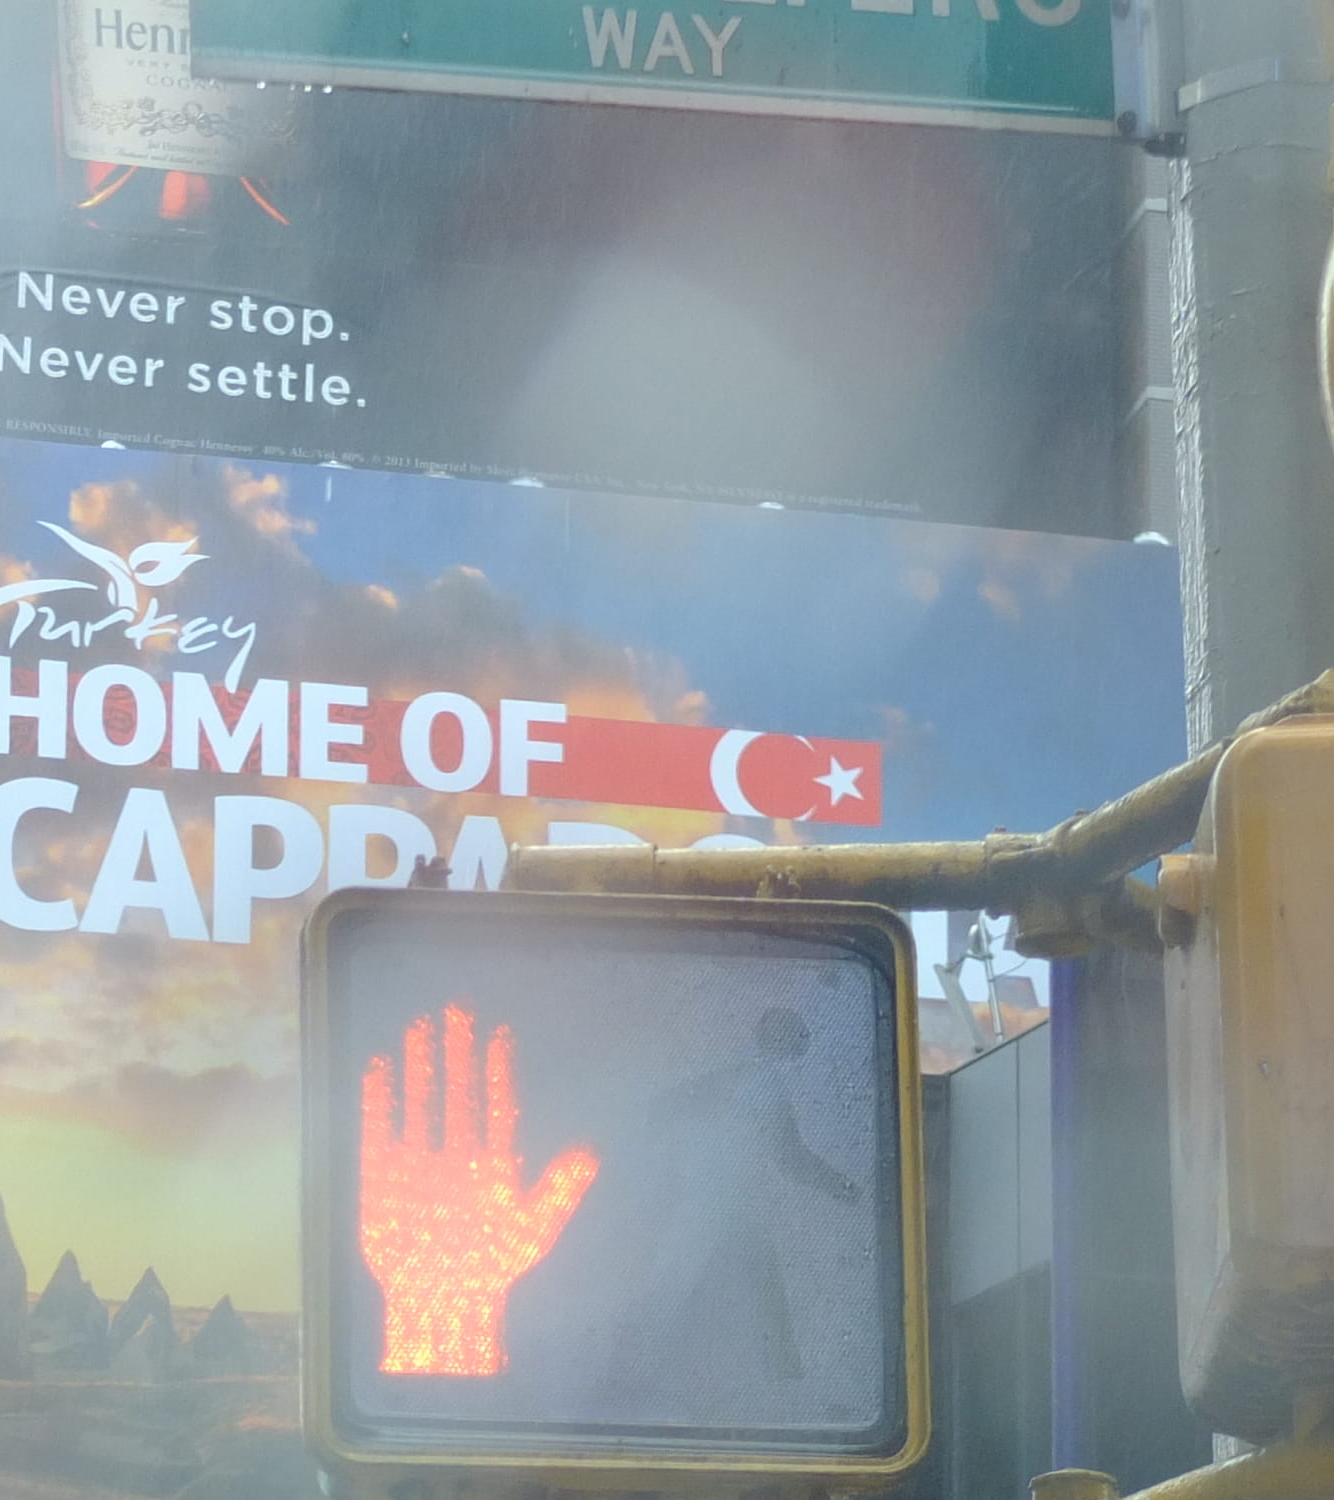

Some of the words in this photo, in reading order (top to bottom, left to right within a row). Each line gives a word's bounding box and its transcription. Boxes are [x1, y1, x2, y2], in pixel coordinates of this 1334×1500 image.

[583, 6, 743, 77] WAY
[17, 270, 186, 325] Never
[209, 295, 351, 346] stop.
[186, 361, 367, 408] settle.
[399, 690, 569, 798] OF
